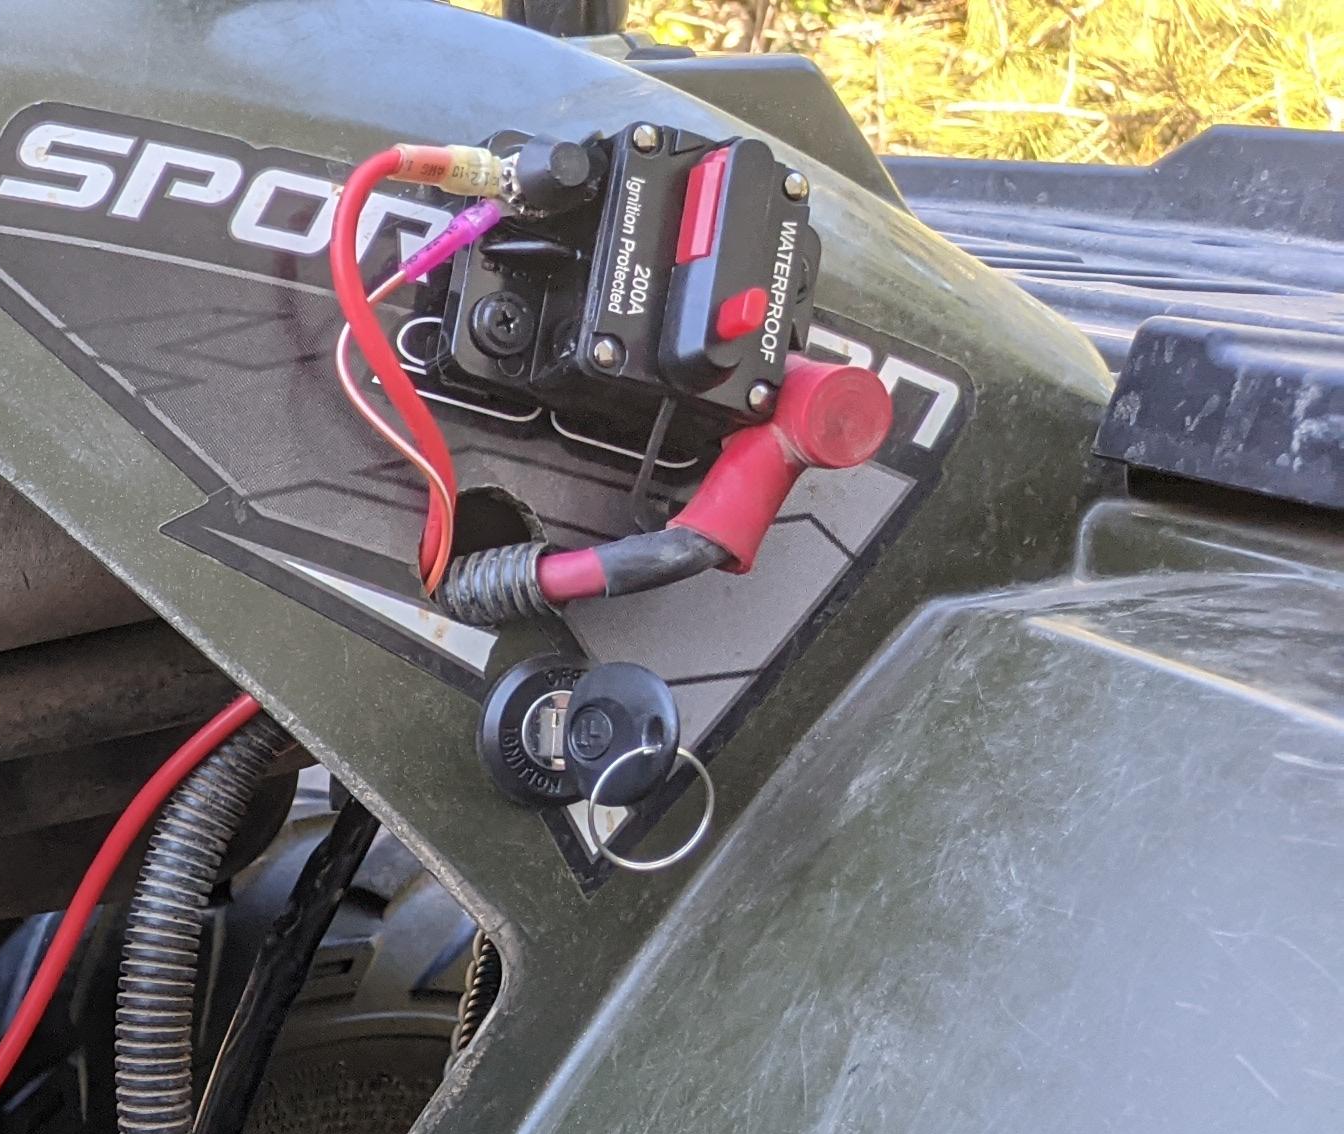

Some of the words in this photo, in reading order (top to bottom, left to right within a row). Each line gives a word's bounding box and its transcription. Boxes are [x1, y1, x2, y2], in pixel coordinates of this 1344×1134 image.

[621, 176, 646, 235] Ignition
[608, 237, 636, 315] Protected
[626, 264, 651, 315] 200A
[759, 221, 798, 364] WATERPROOF
